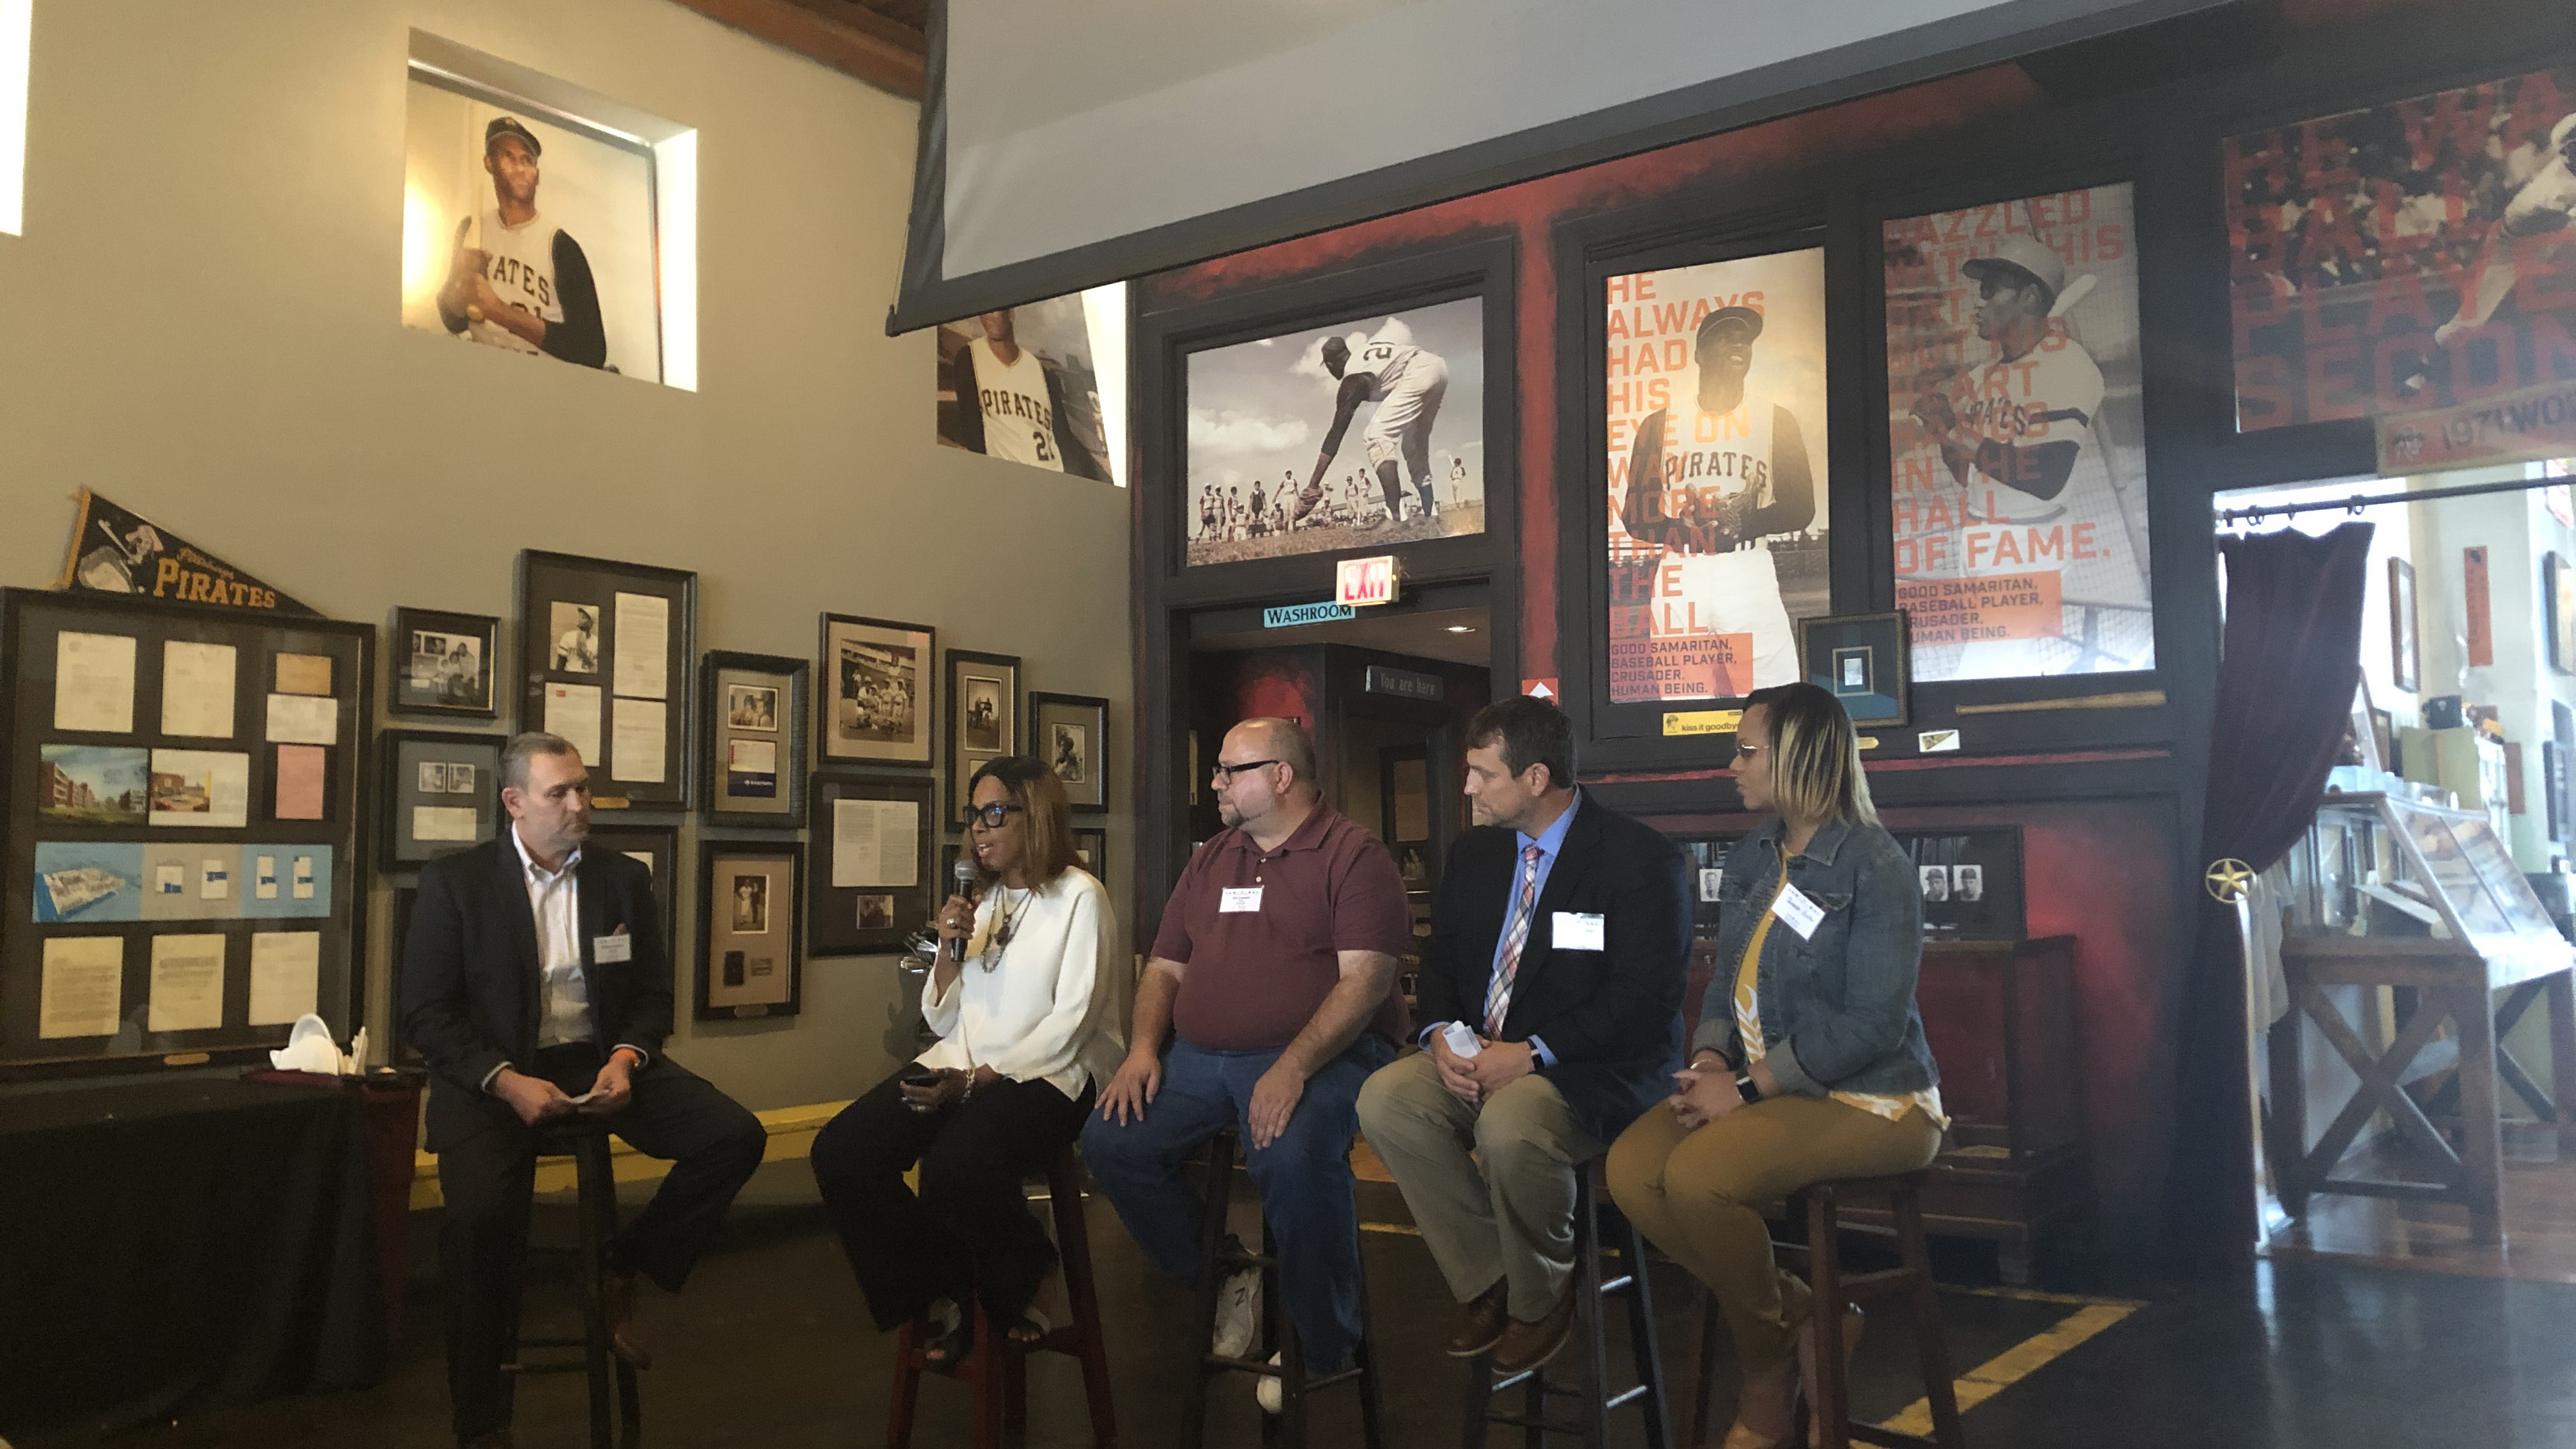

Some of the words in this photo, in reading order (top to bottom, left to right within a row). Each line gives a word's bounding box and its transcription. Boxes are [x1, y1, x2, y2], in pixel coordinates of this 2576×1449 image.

[1607, 271, 1657, 305] HE
[1607, 339, 1688, 378] HAD
[981, 388, 1052, 431] PIRATES
[1607, 378, 1671, 415] HIS
[1694, 407, 1751, 443] ON
[1608, 486, 1721, 526] MORE
[1893, 490, 2011, 534] HALL
[1608, 526, 1717, 564] THAN
[1894, 536, 1949, 574] OF
[1966, 522, 2111, 569] FAME.
[153, 557, 275, 609] PIRATES
[1344, 560, 1389, 601] EXIT
[1609, 565, 1683, 601] THE
[1898, 585, 1938, 599] GOOD
[1267, 604, 1352, 624] WASHROOM
[1609, 601, 1710, 638] BALL
[1960, 625, 2011, 640] BEING.
[1611, 643, 1646, 655] GOOD
[1611, 656, 1678, 668] BASEBALL
[1612, 684, 1660, 696] HUMAN
[1664, 682, 1708, 694] BEING.
